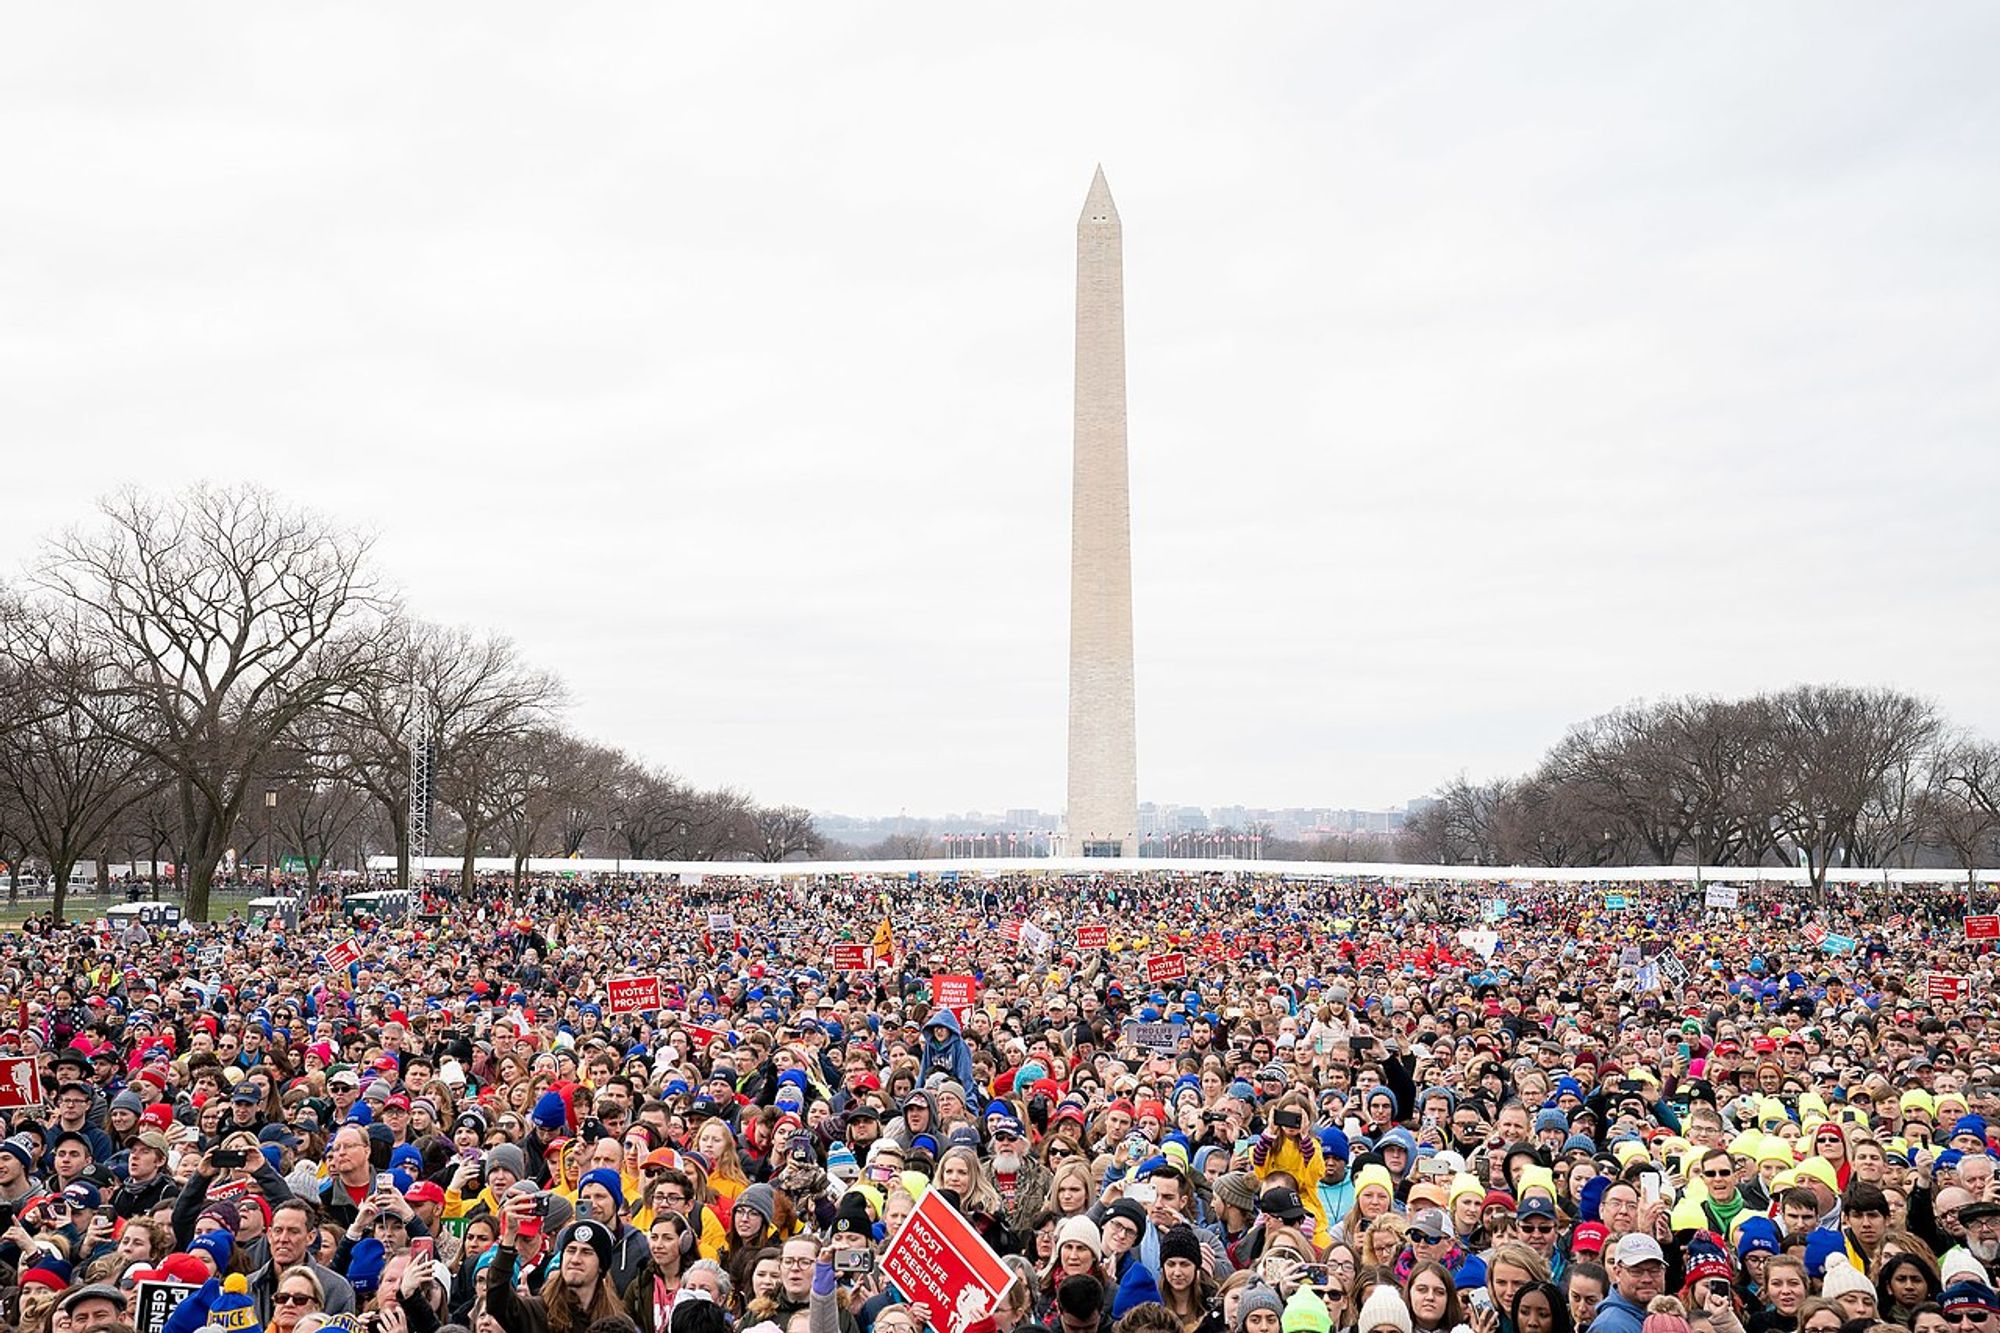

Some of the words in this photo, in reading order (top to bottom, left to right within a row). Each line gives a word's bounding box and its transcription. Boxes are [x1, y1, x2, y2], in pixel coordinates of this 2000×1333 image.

[1153, 960, 1173, 970] VOTE
[613, 995, 656, 1008] PRO-LIFE
[618, 986, 645, 997] VOTE
[912, 1221, 944, 1255] MOST
[904, 1233, 949, 1284] PRO-LIFE
[889, 1258, 918, 1294] EVER.
[897, 1245, 951, 1310] PRESIDENT.
